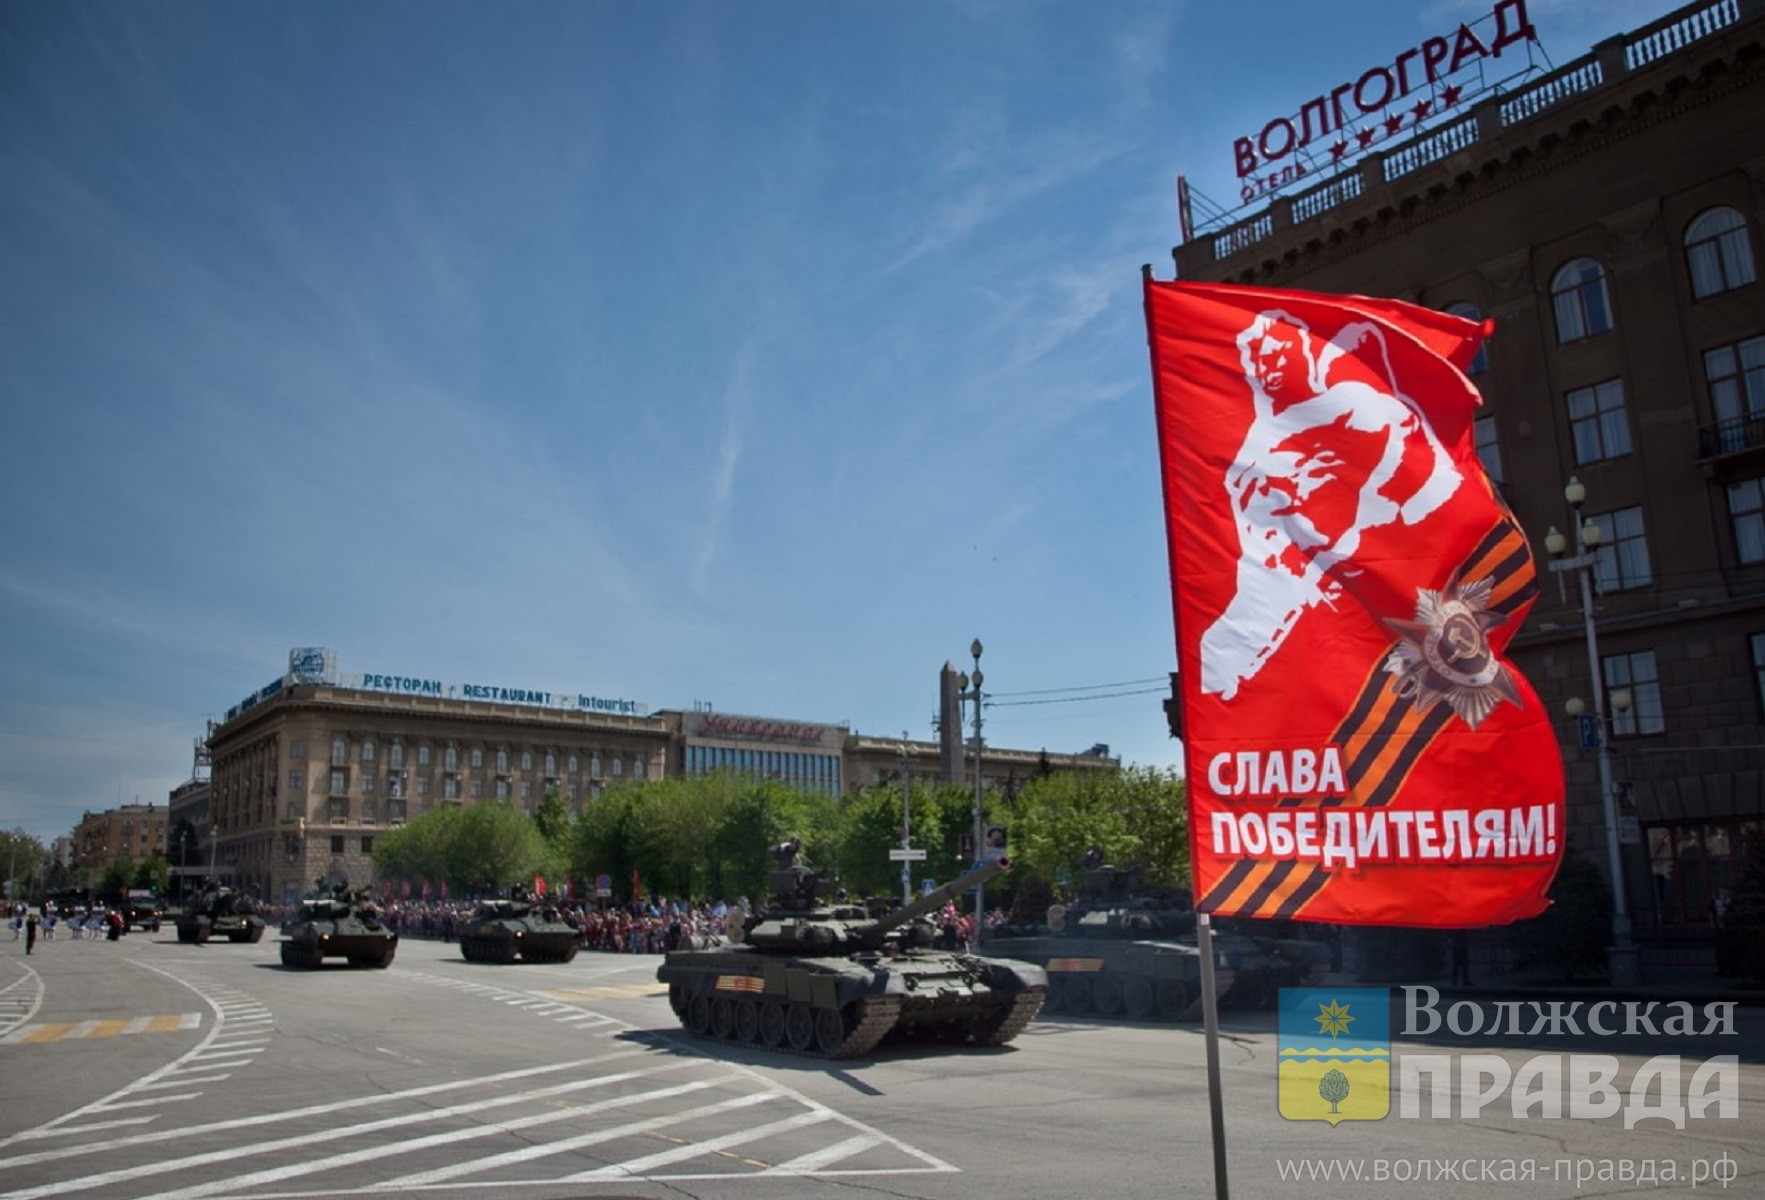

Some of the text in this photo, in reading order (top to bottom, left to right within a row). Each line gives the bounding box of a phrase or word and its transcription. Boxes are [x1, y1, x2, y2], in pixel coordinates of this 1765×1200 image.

[1234, 0, 1535, 178] ВОЛГОГРАД
[1241, 162, 1306, 200] ОТЕЛЬ
[363, 673, 441, 694] РЕСТОРАН
[463, 683, 551, 706] RESTAURANT
[1208, 747, 1346, 796] СЛАВА
[1211, 803, 1556, 869] ПОБЕДИТЕЛЯМ!
